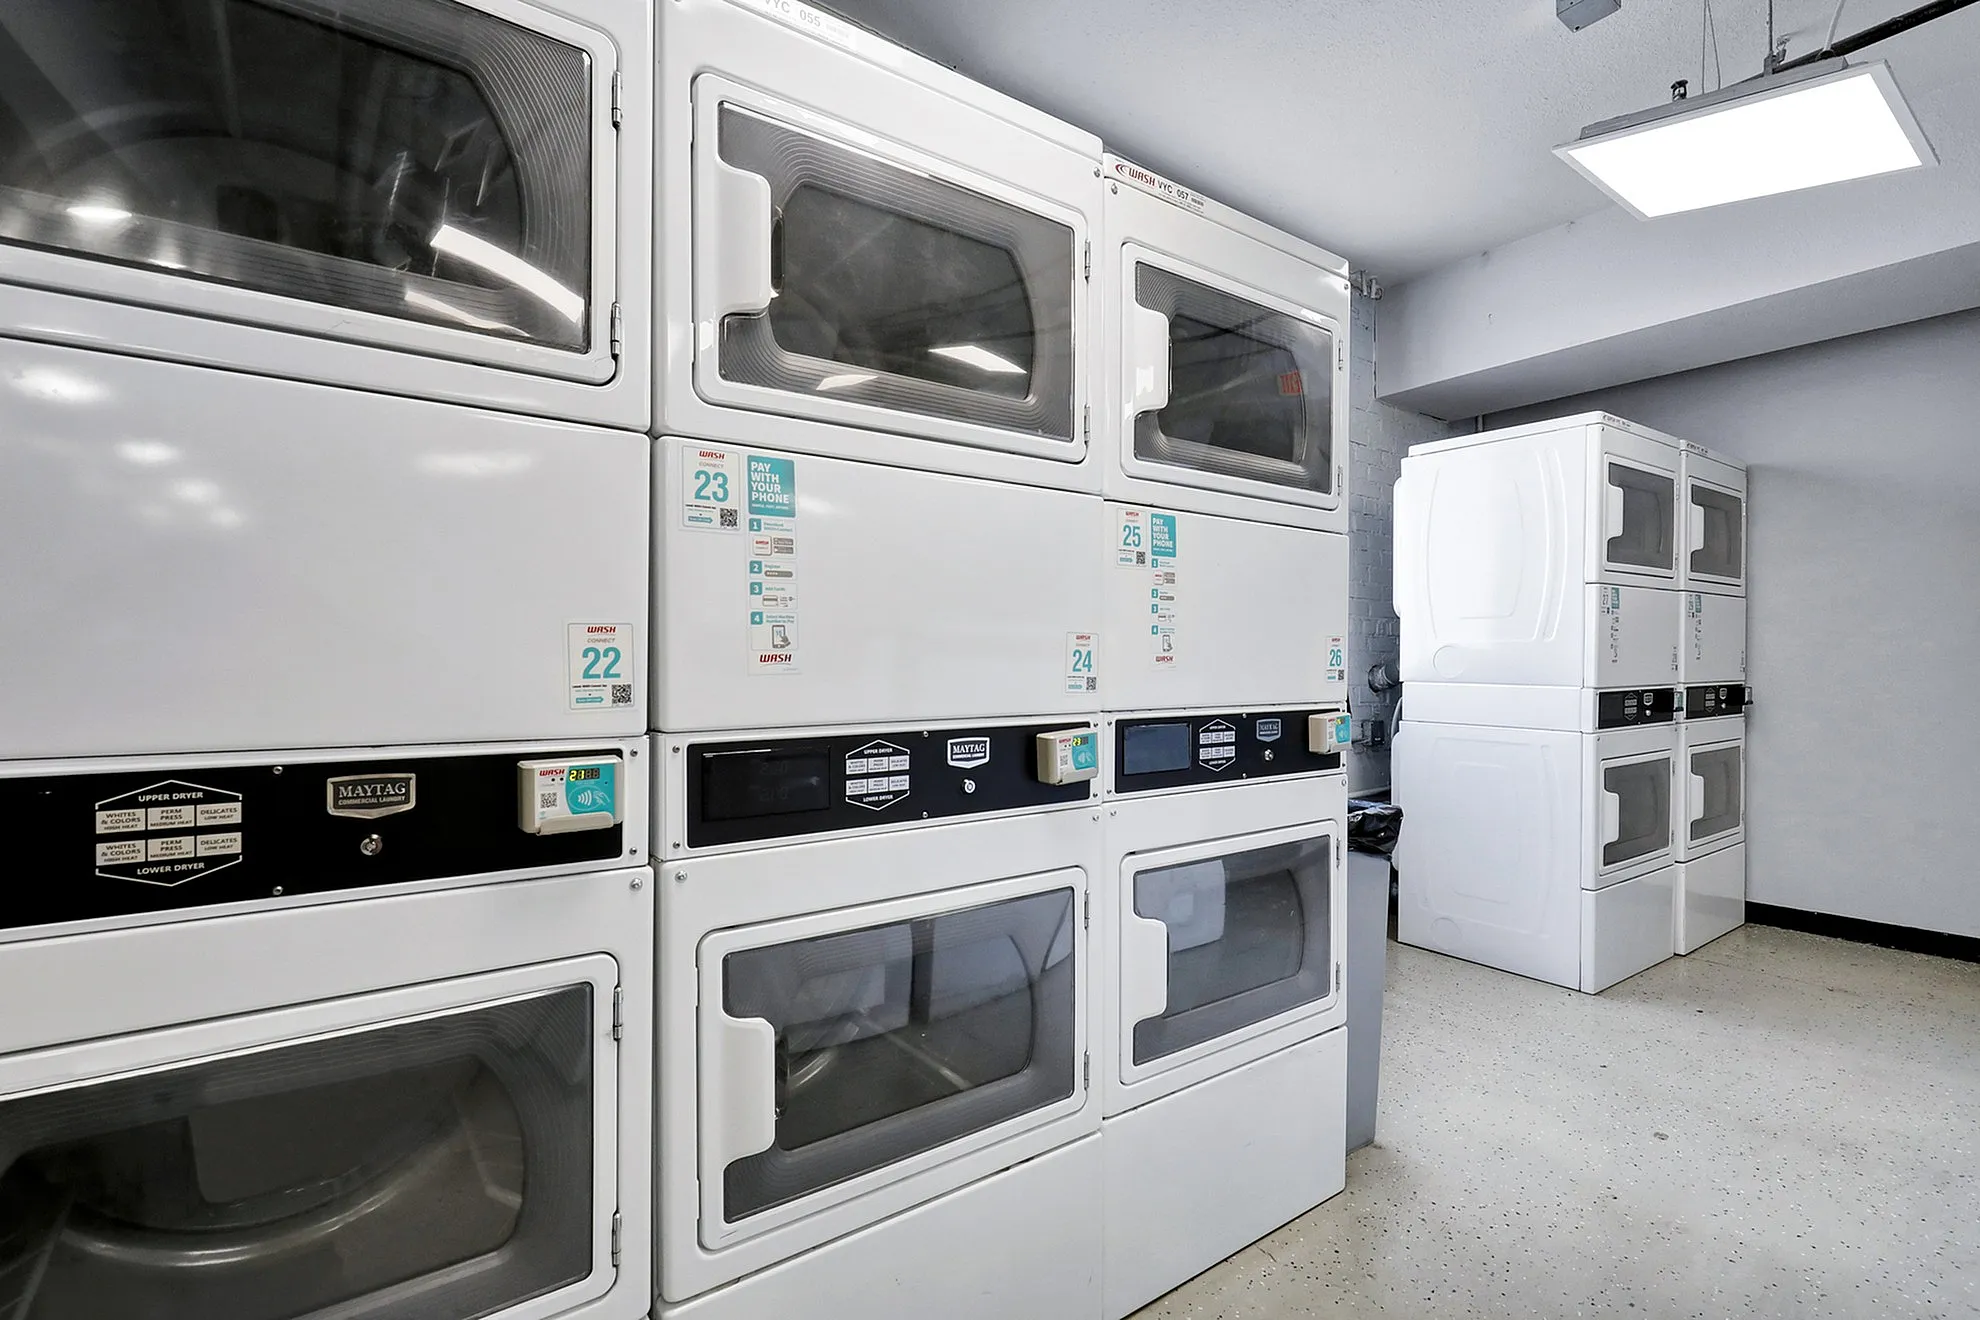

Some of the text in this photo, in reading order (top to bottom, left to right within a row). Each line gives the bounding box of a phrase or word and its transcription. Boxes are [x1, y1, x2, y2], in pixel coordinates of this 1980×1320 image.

[799, 10, 821, 27] 055
[1128, 167, 1189, 200] WASH VYC 057
[699, 450, 725, 459] WASH
[698, 461, 724, 469] CONNECT
[750, 462, 771, 473] PAY
[751, 472, 779, 484] WITH
[694, 470, 729, 503] 23
[751, 482, 781, 493] YOUR
[751, 492, 790, 504] PHONE
[752, 521, 759, 529] 1
[1123, 525, 1141, 547] 25
[752, 563, 759, 572] 2
[753, 585, 759, 593] 3
[759, 654, 792, 662] WASH
[1072, 649, 1092, 672] 24
[1329, 648, 1342, 667] 26
[582, 647, 621, 679] 22
[953, 743, 985, 753] MAYTAG
[539, 769, 565, 777] WASH
[569, 770, 585, 782] 21
[338, 782, 406, 798] MAYTAG
[138, 792, 204, 802] UPPER DRYER
[201, 807, 237, 815] DELICATES
[110, 817, 141, 825] COLORS
[106, 843, 136, 851] WHITES
[201, 838, 237, 846] DELICATES
[110, 849, 141, 857] COLORS
[137, 862, 205, 875] LOWER DRYER
